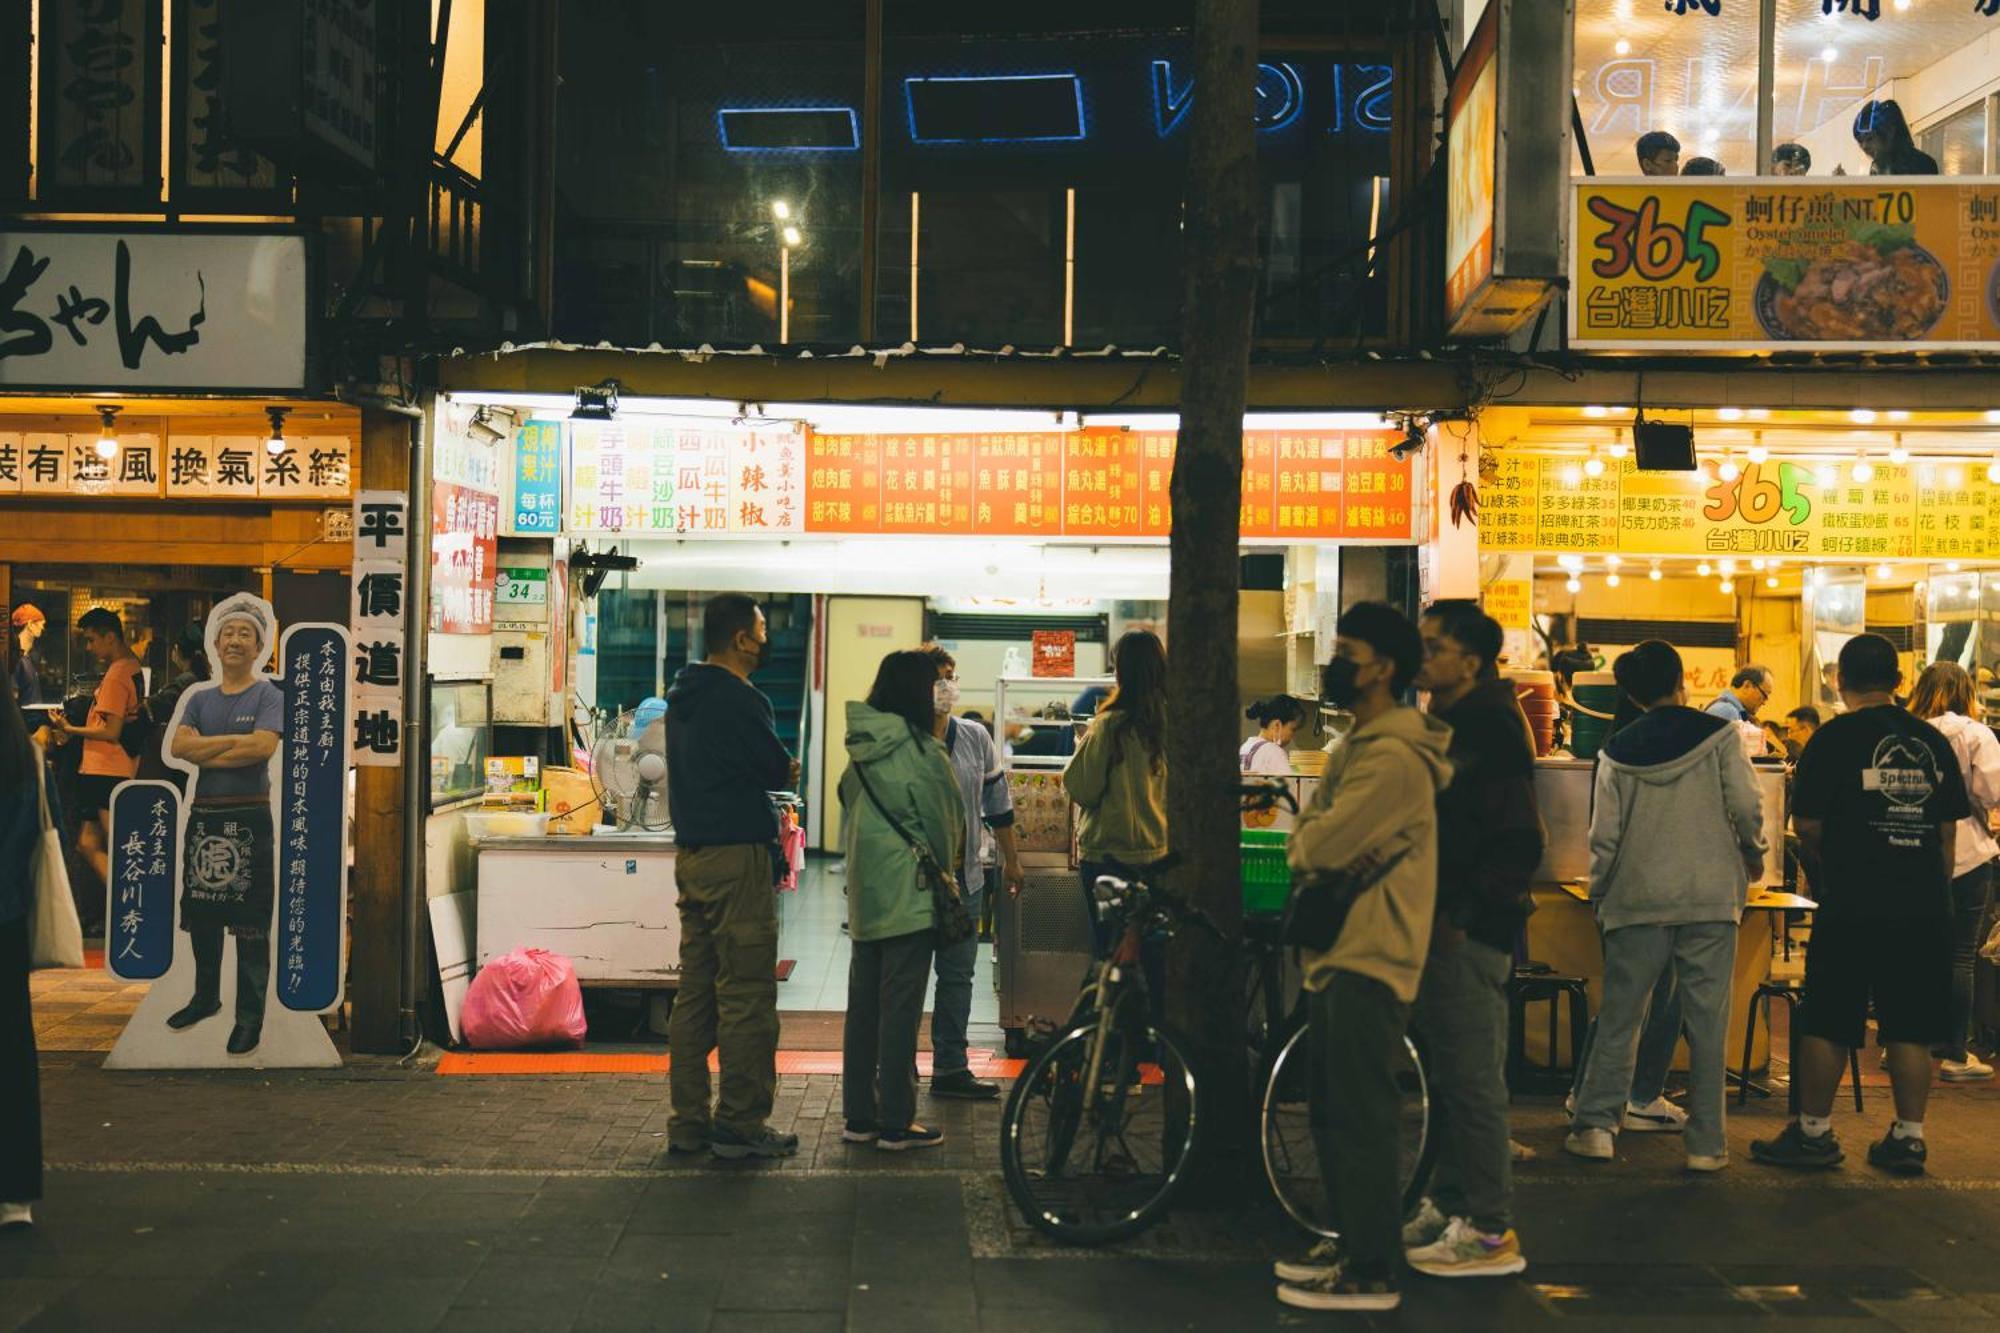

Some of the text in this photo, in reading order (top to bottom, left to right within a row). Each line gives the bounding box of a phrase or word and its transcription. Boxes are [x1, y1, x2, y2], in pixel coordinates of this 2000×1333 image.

[1745, 192, 1835, 224] 蚵仔煎
[1587, 195, 1732, 282] 365
[1587, 286, 1730, 329] 台灣小吃
[676, 428, 703, 530] 西瓜汁
[740, 430, 769, 528] 小辣椒
[1279, 470, 1319, 493] 魚丸湯
[1703, 459, 1818, 525] 365
[1541, 496, 1600, 510] 多多綠茶
[1622, 498, 1681, 513] 椰果奶茶
[518, 511, 555, 528] 60元
[1541, 515, 1600, 529] 招牌紅茶
[1621, 515, 1681, 530] 巧克力奶茶
[1540, 533, 1600, 548] 經典奶茶
[1706, 527, 1810, 553] 台灣小吃
[508, 583, 530, 599] 34
[353, 503, 404, 754] 平價道地
[149, 799, 169, 876] 本店主廚
[118, 830, 147, 960] 長谷川秀人
